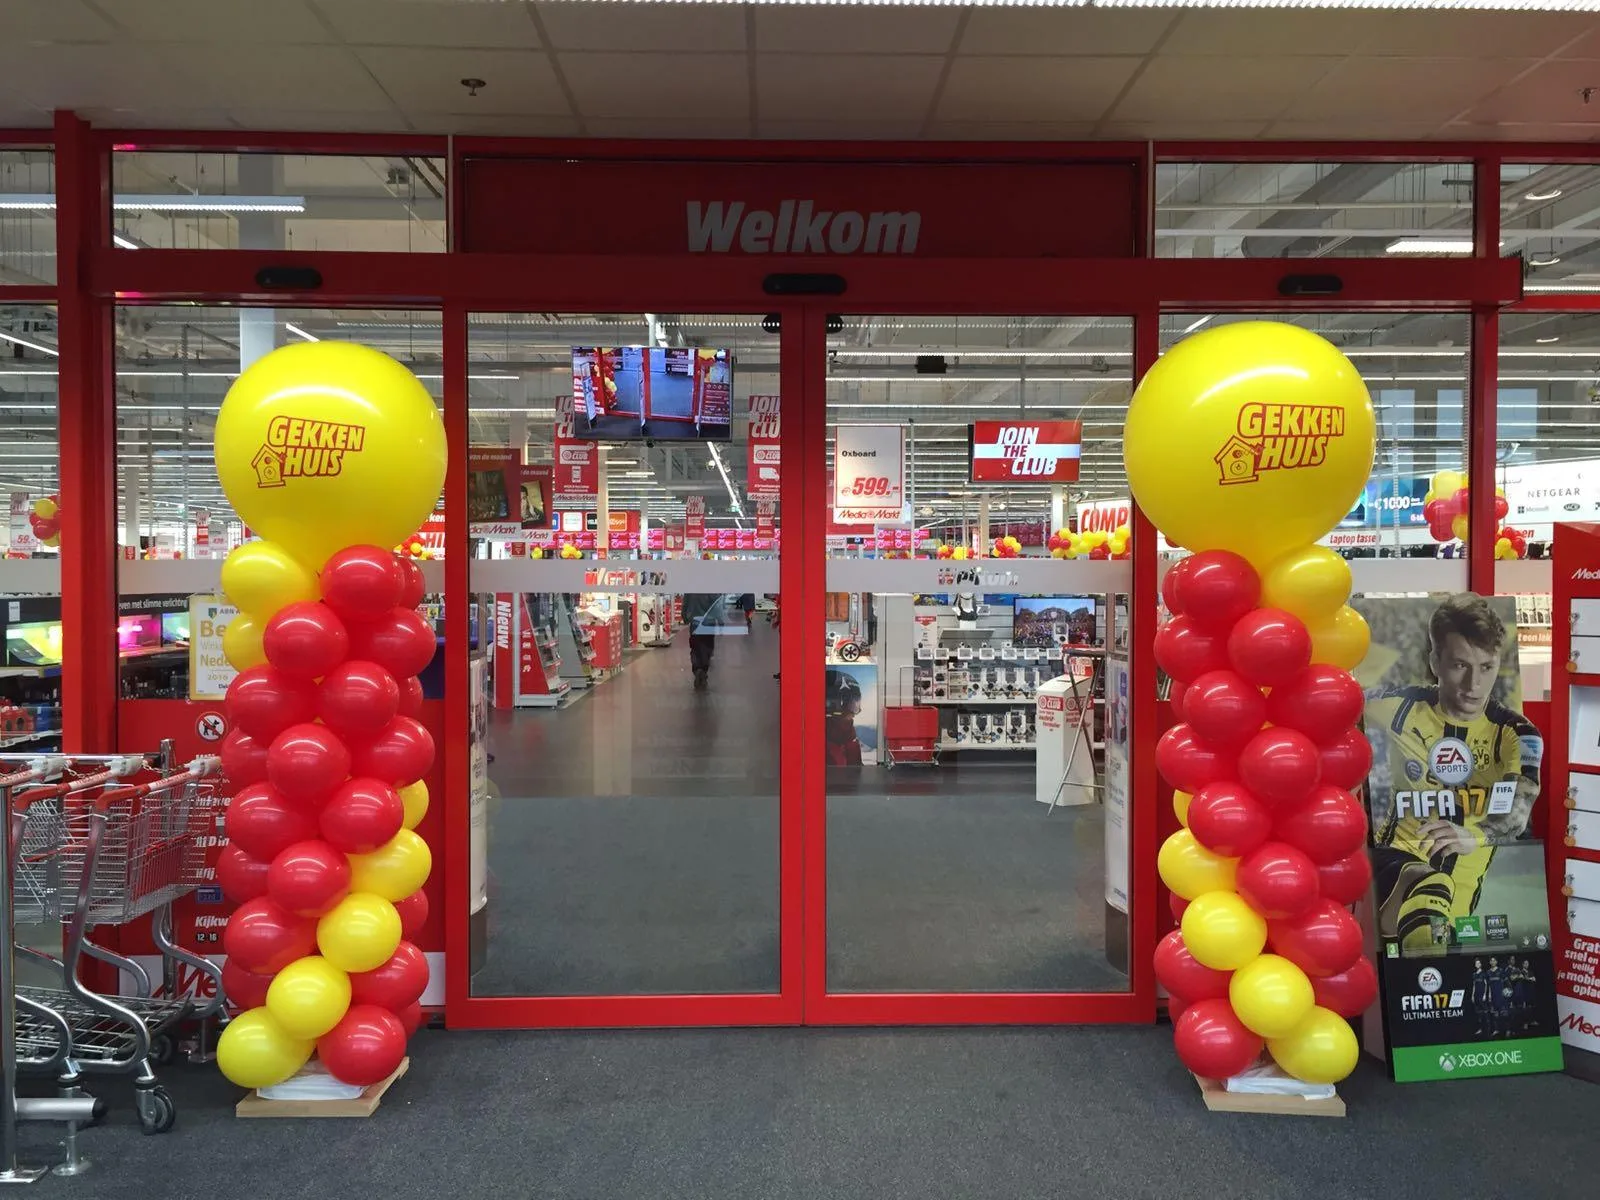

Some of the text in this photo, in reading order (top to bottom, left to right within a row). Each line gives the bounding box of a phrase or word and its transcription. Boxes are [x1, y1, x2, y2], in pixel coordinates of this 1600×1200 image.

[686, 200, 922, 254] Welkom
[1236, 402, 1345, 438] GEKKEN
[267, 415, 366, 452] GEKKEN
[751, 421, 780, 438] CLU
[996, 427, 1039, 445] JOIN
[1003, 445, 1028, 457] THE
[1255, 435, 1329, 471] HUIS
[281, 447, 345, 477] HUIS
[1011, 458, 1058, 475] CLUB
[1528, 487, 1581, 498] NETGEAR
[429, 513, 445, 522] ken
[839, 510, 901, 519] Media Markt
[1330, 534, 1356, 544] Laptop
[1521, 529, 1535, 538] en
[200, 620, 228, 637] Be
[497, 600, 512, 650] Nieuw
[1436, 747, 1467, 765] EA
[1435, 764, 1469, 774] SPORTS
[1495, 786, 1513, 794] FIFA
[1395, 787, 1487, 819] FIFA 17
[194, 915, 232, 929] Kijkw
[197, 933, 205, 942] 12
[1564, 949, 1599, 965] snel en
[1572, 962, 1595, 974] veilig
[1422, 972, 1438, 982] EA
[1401, 993, 1449, 1011] FIFA 17
[1403, 1008, 1464, 1021] ULTIMATE TEAM
[1458, 1050, 1523, 1068] XBOX ONE
